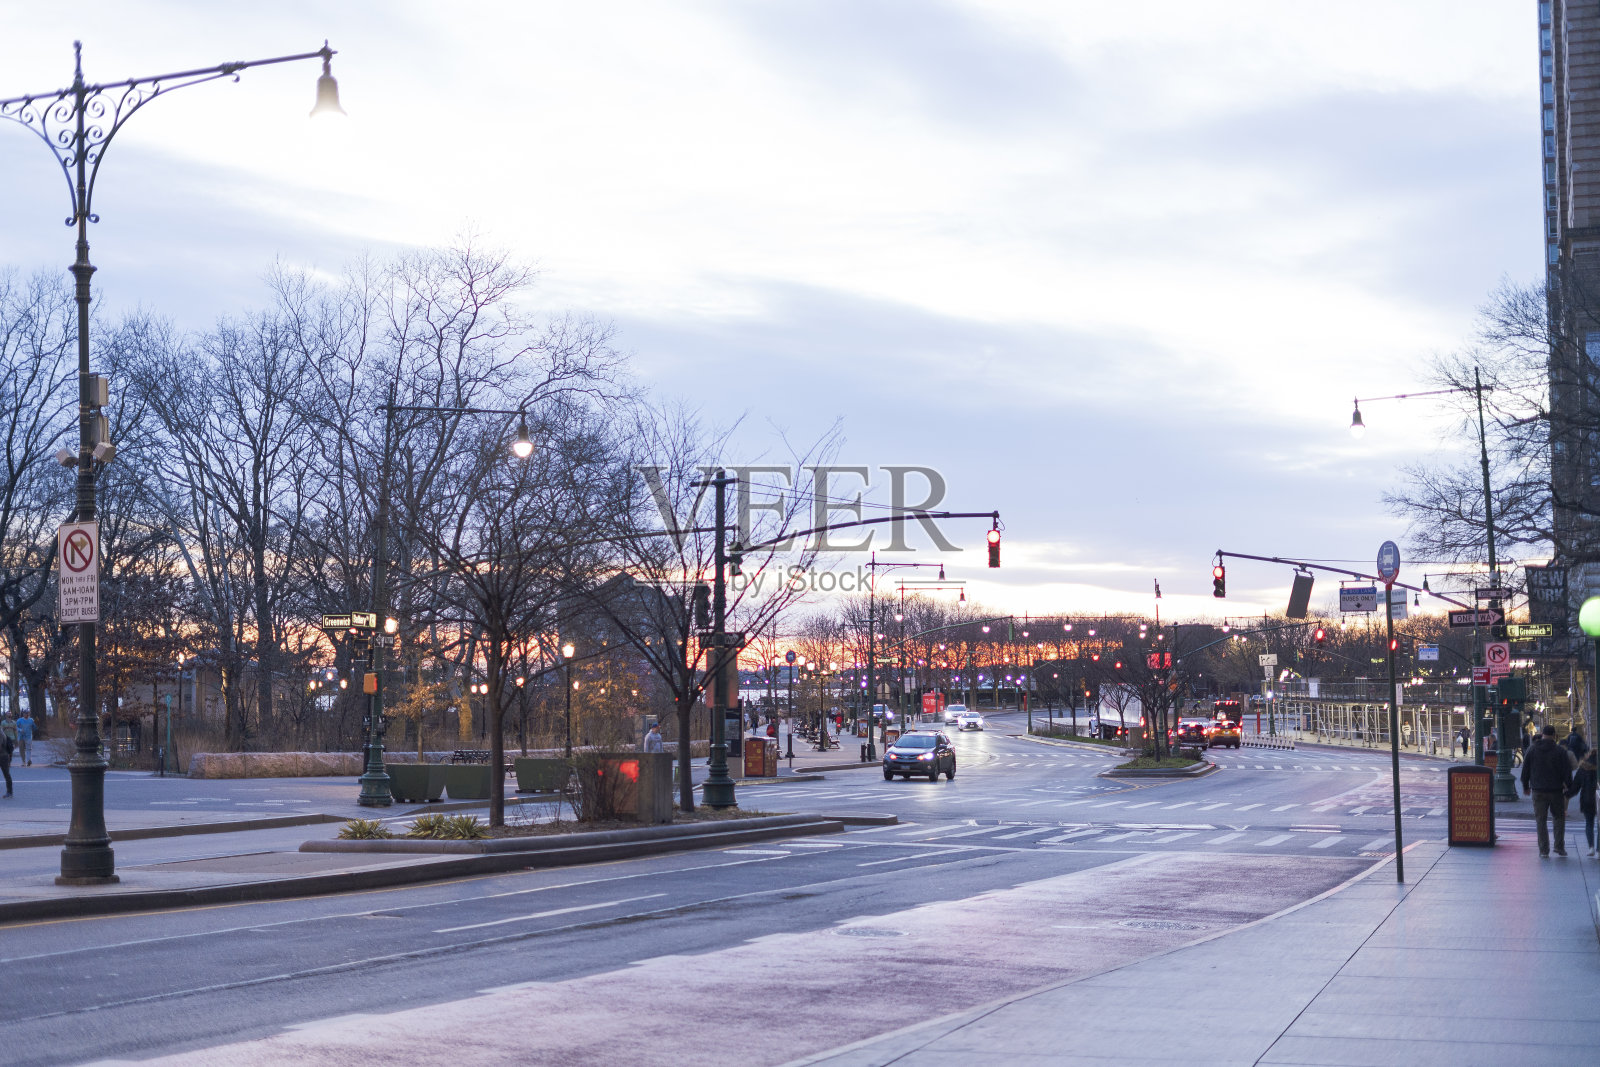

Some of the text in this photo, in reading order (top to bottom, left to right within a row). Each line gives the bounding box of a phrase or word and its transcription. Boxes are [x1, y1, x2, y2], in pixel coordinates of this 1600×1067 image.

[86, 575, 96, 583] FRI
[63, 585, 95, 595] 6AM-10AM
[64, 597, 94, 606] 3PM-7PM
[62, 607, 96, 616] EXCEPT BUSES
[324, 618, 350, 626] Greenwich
[1456, 613, 1497, 623] ONE WAY
[1519, 627, 1546, 636] Greenwich
[1454, 776, 1486, 784] DO YOU
[1455, 792, 1486, 800] DO YOU
[1455, 807, 1487, 815] DO YOU
[1456, 823, 1487, 831] DO YOU
